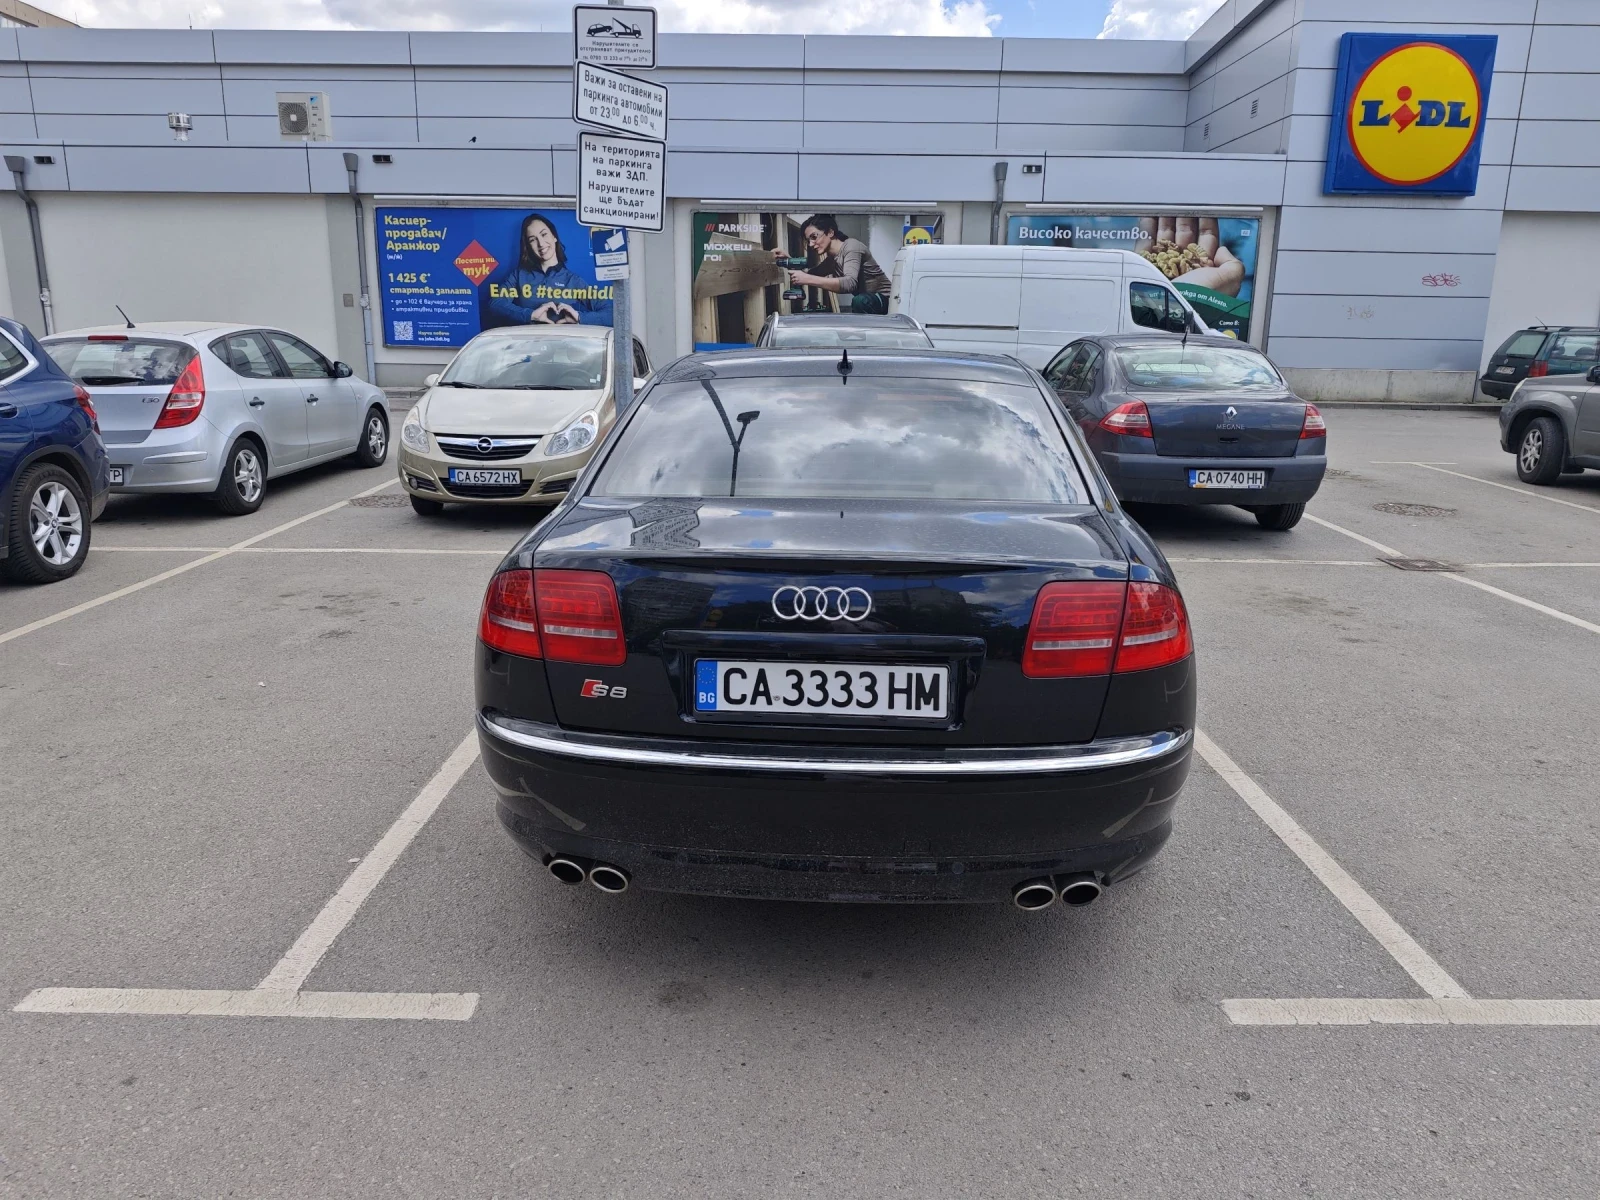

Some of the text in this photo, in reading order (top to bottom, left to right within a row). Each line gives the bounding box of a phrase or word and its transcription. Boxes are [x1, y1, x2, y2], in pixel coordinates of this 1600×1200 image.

[585, 70, 662, 102] Важи за оставени на
[584, 88, 662, 118] паркинга автомобили
[1359, 86, 1472, 134] LIDL
[590, 106, 598, 115] от
[622, 115, 631, 125] до
[585, 142, 660, 159] На територията
[609, 158, 652, 170] паркинга
[596, 169, 648, 181] важи ЗДП.
[588, 181, 654, 196] Нарушителите
[599, 196, 612, 204] ще
[583, 206, 658, 220] санкционирани!
[384, 215, 432, 227] Касиер-
[718, 224, 764, 232] PARKSIDE
[385, 227, 447, 240] продавач/
[1019, 226, 1152, 240] Високо качество.
[386, 240, 440, 252] Аранжор
[463, 264, 490, 278] тук
[390, 286, 434, 295] стартова
[490, 283, 613, 300] Ела в #teamlidl
[1208, 296, 1228, 308] Alesto.
[457, 471, 471, 482] CA
[474, 472, 501, 483] 6572
[503, 472, 518, 483] HX
[1198, 472, 1262, 484] CA 0740 HH
[591, 684, 627, 699] S8
[699, 667, 940, 711] BG CA 3333 HM
